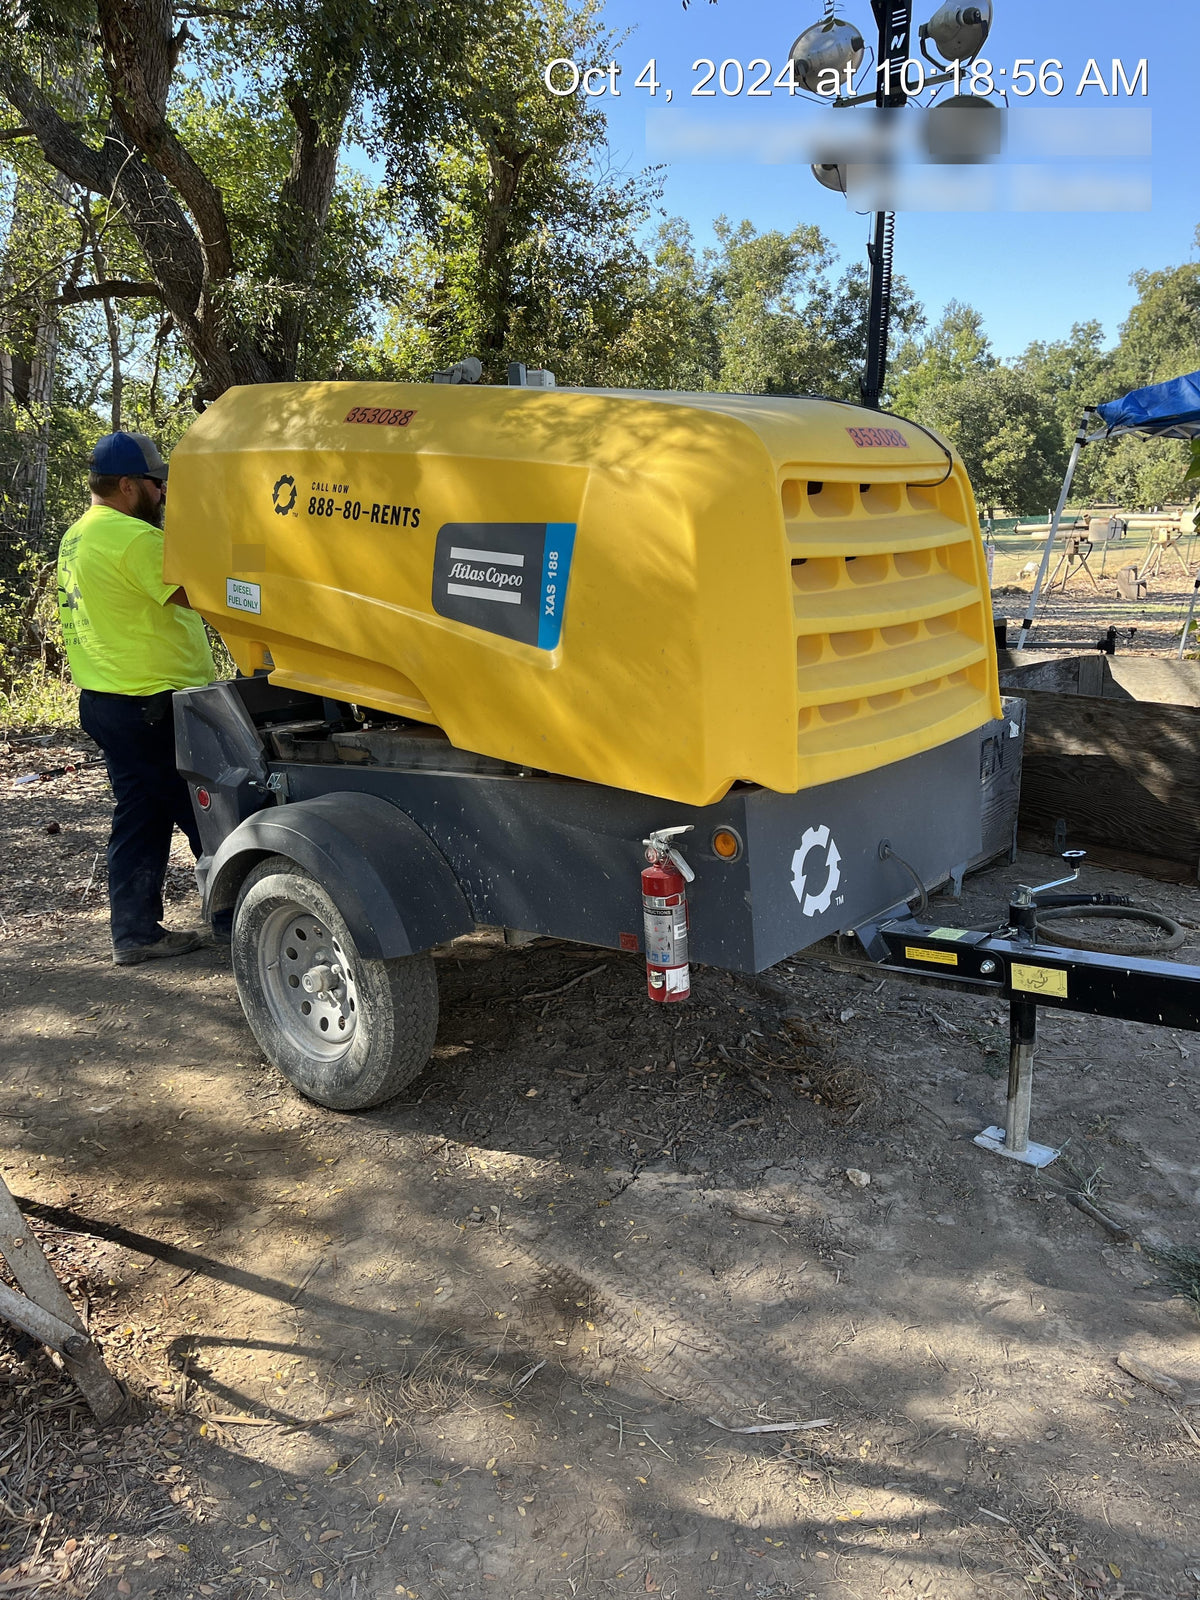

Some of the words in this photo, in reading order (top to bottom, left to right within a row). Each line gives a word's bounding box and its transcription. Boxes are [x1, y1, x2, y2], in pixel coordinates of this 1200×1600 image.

[346, 407, 414, 426] 353088
[849, 428, 907, 447] 353088
[311, 481, 329, 492] CALL
[332, 484, 350, 494] NOW
[307, 496, 421, 528] 888-80-RENTS
[547, 551, 559, 579] 188
[232, 583, 253, 596] DIESEL
[228, 594, 242, 606] FUEL
[243, 598, 259, 609] ONLY
[545, 584, 557, 616] XAS
